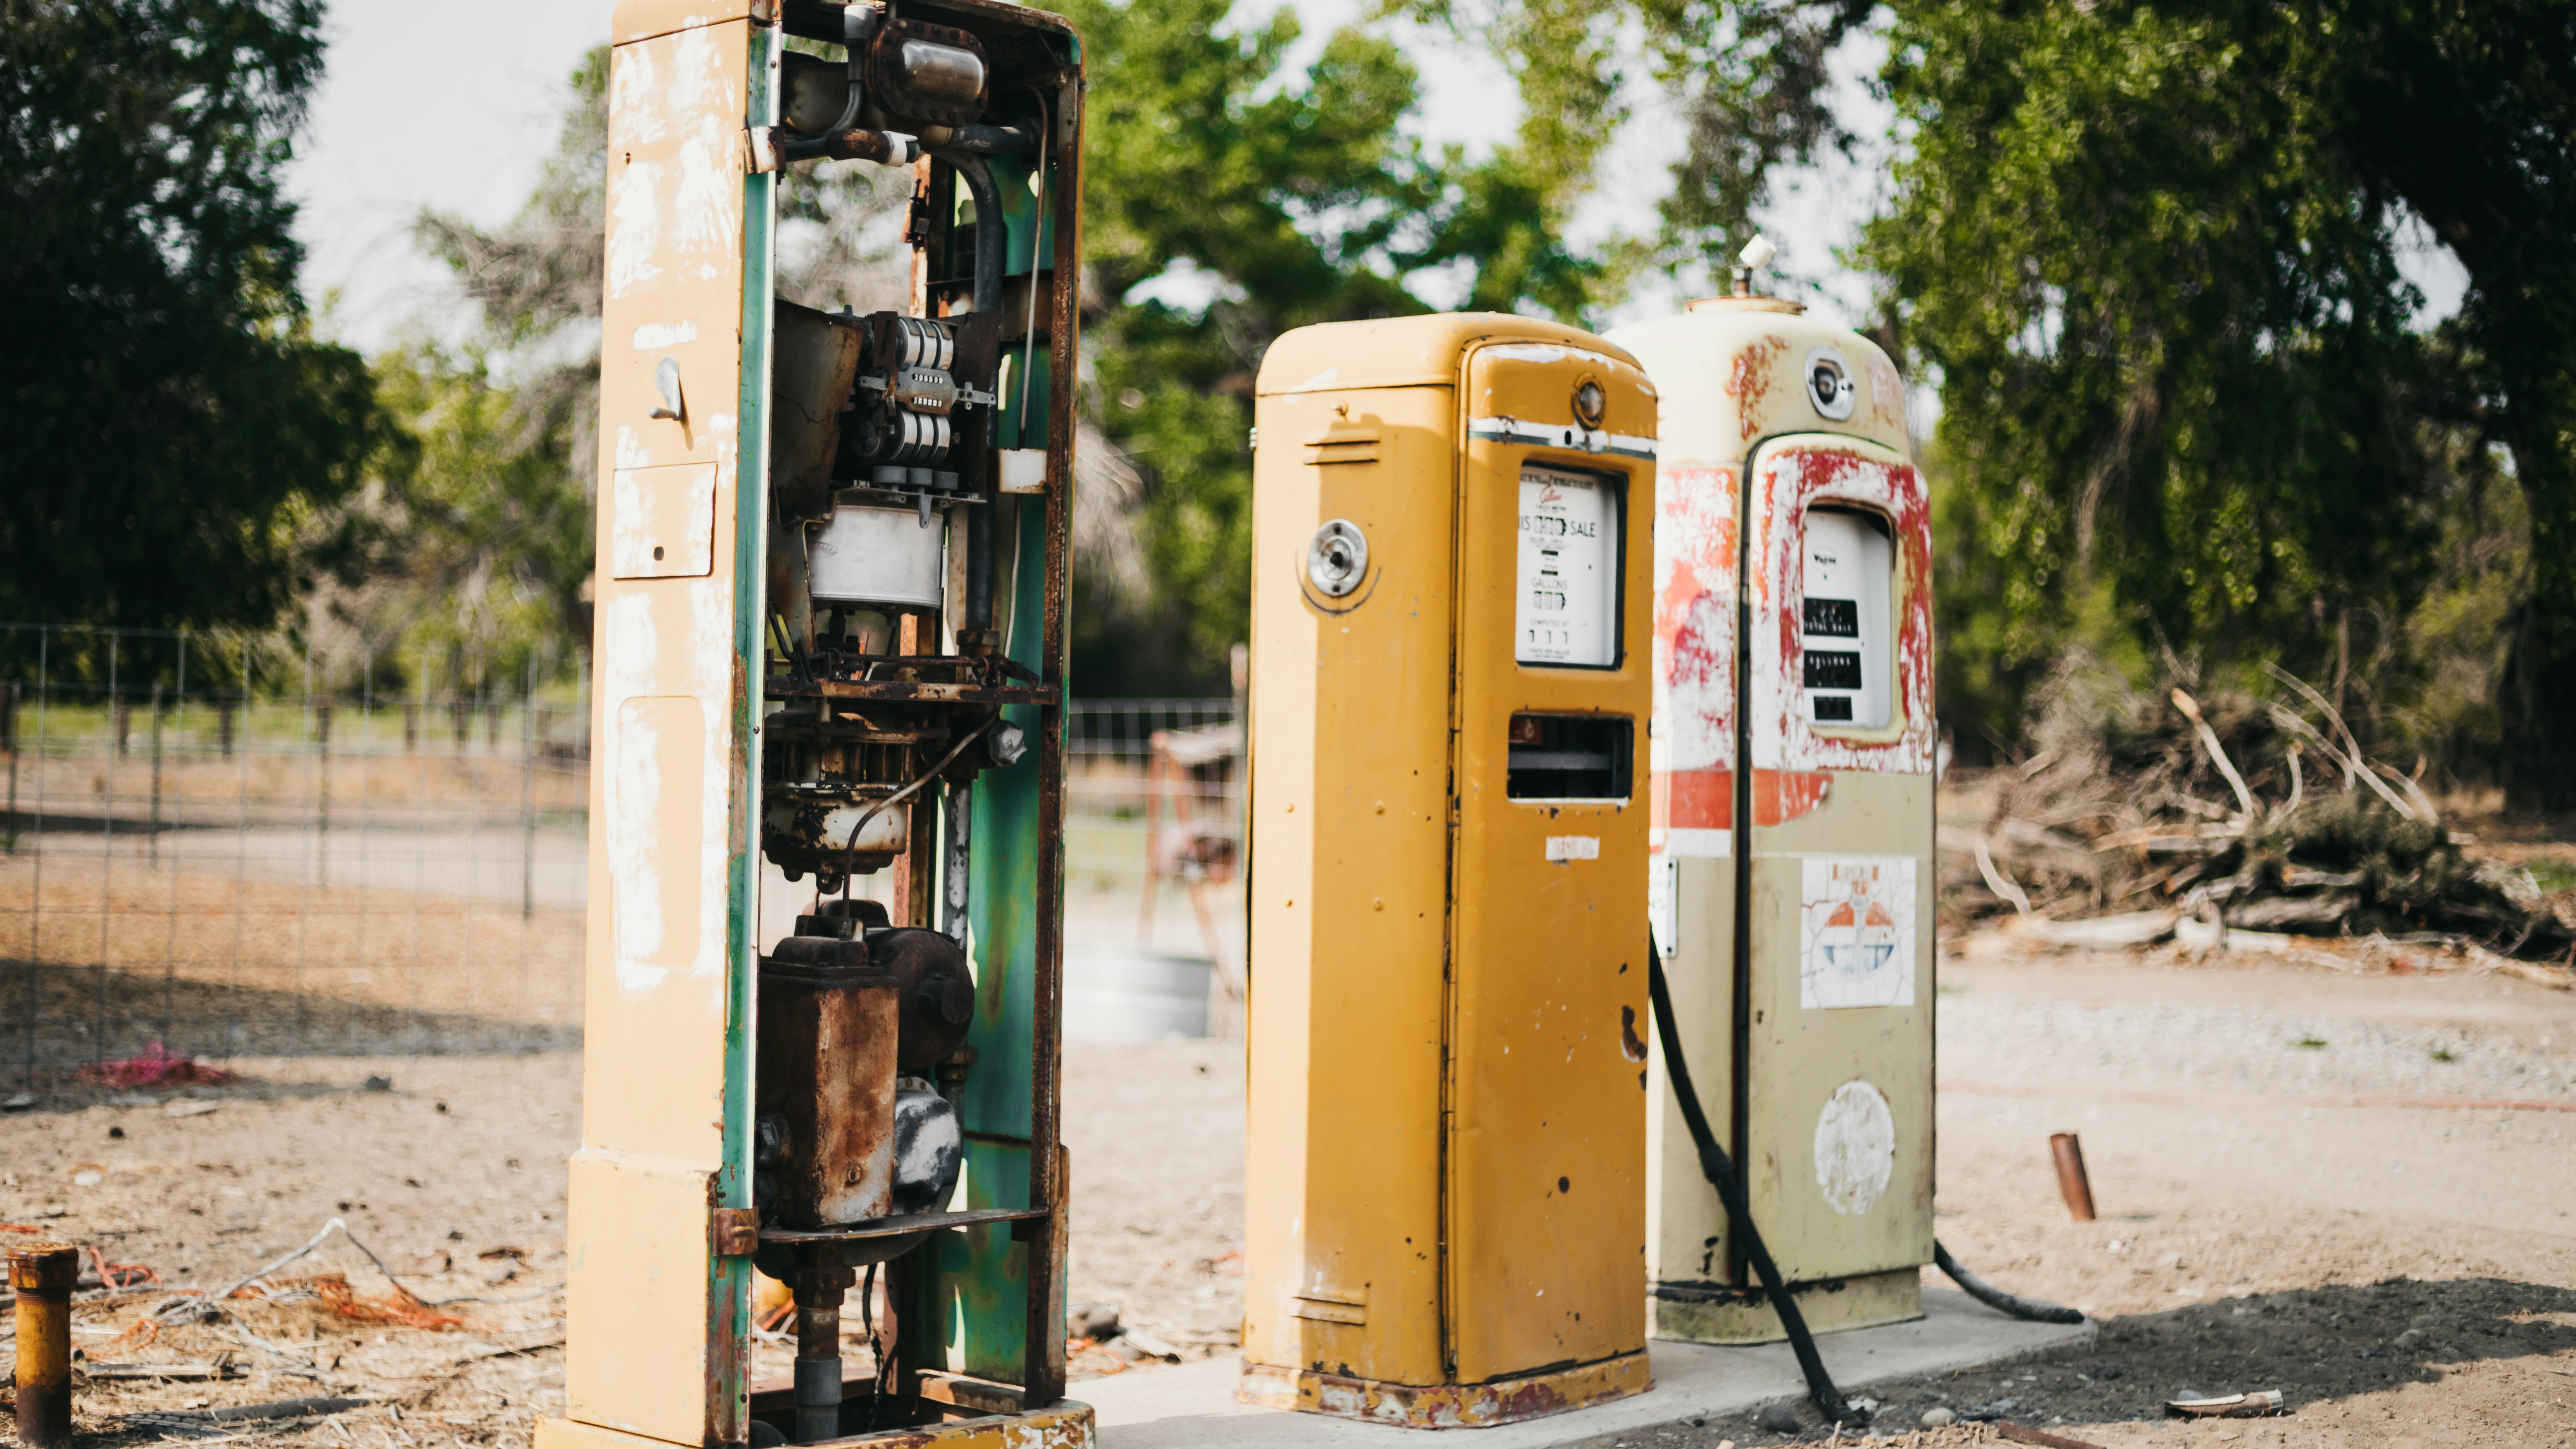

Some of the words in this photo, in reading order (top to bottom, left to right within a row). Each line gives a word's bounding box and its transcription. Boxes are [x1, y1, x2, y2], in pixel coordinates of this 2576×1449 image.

[1519, 515, 1531, 531] IS
[1570, 521, 1595, 537] SALE
[1532, 577, 1567, 590] GALLONS
